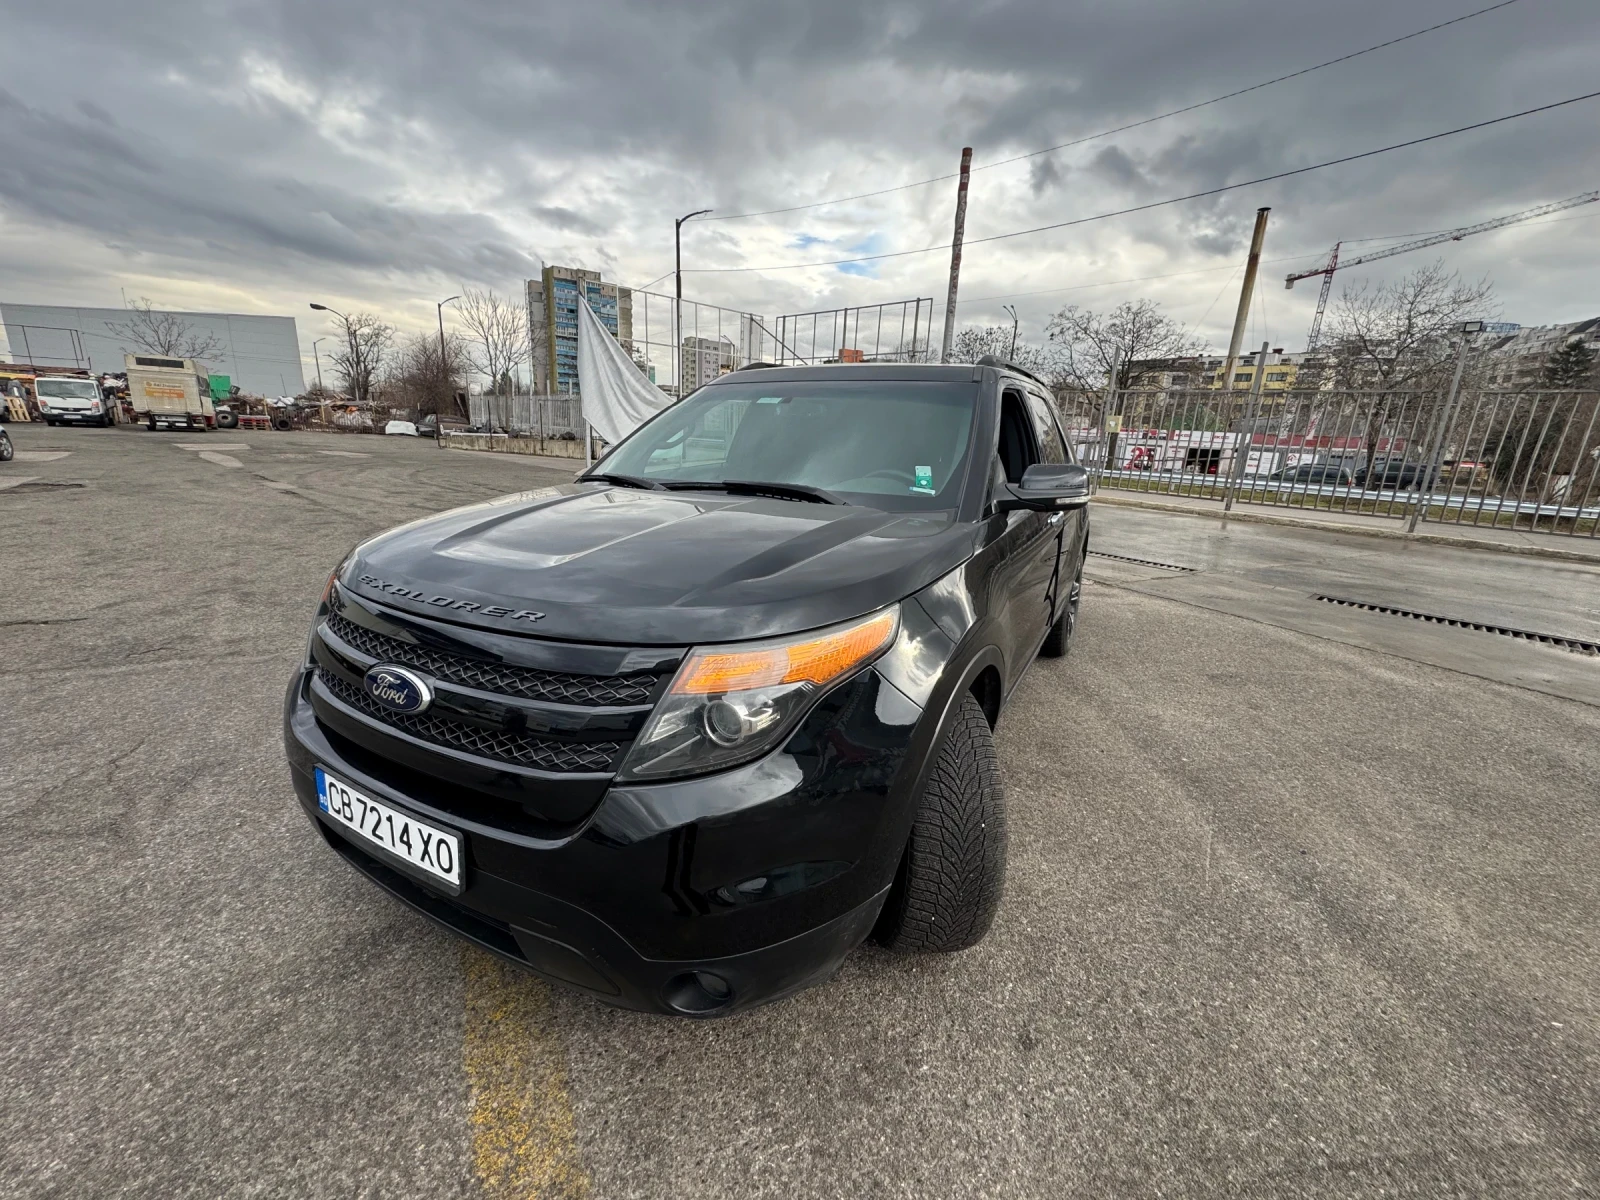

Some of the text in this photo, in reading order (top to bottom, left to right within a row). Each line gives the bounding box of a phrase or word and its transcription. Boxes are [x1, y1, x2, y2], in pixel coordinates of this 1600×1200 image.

[357, 574, 547, 623] EXPLORER
[372, 673, 407, 705] Ford
[319, 793, 328, 806] BG
[328, 781, 453, 874] CB7214XO
